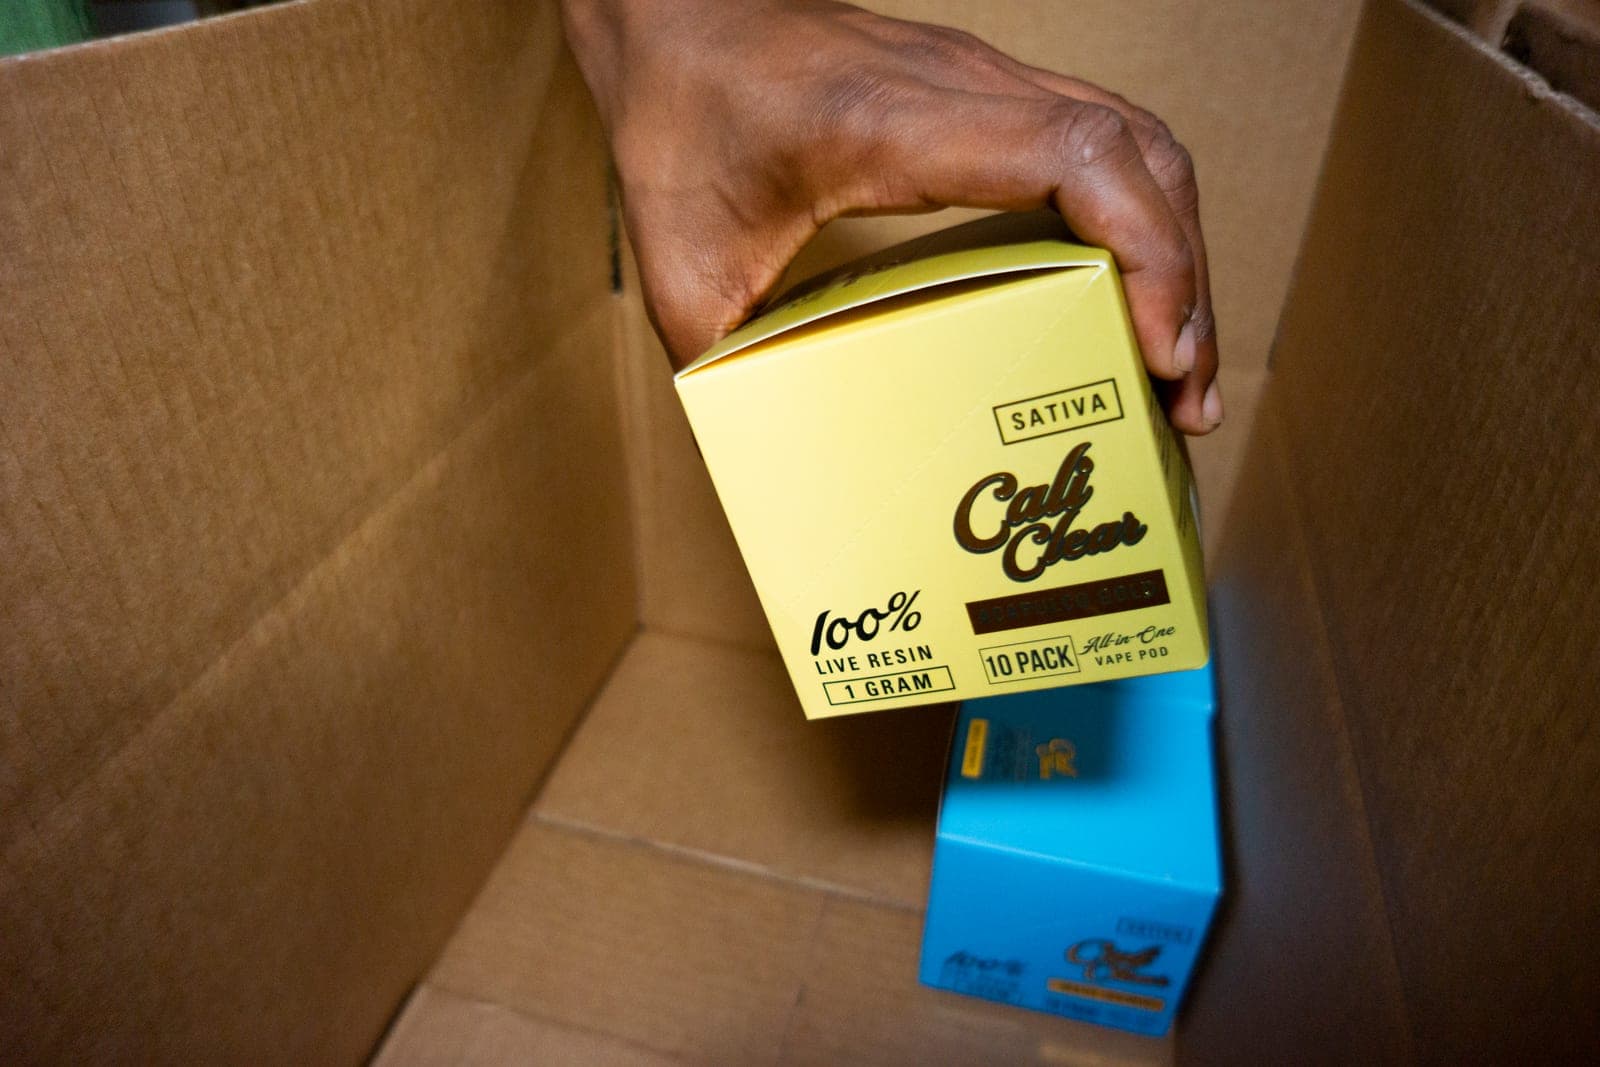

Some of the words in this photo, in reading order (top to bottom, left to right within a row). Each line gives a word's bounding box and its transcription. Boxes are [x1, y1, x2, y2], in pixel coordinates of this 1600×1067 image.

[1011, 393, 1107, 431] SATIVA
[953, 441, 1095, 554] Cali
[1002, 509, 1148, 583] Clear
[810, 589, 922, 656] 100%
[1078, 625, 1176, 656] All-in-One
[1095, 652, 1133, 667] VAPE
[1139, 646, 1169, 661] POD
[815, 656, 860, 675] LIVE
[867, 645, 933, 668] RESIN
[985, 653, 1013, 678] 10
[1015, 644, 1074, 674] PACK
[844, 684, 855, 699] 1
[865, 673, 933, 697] GRAM
